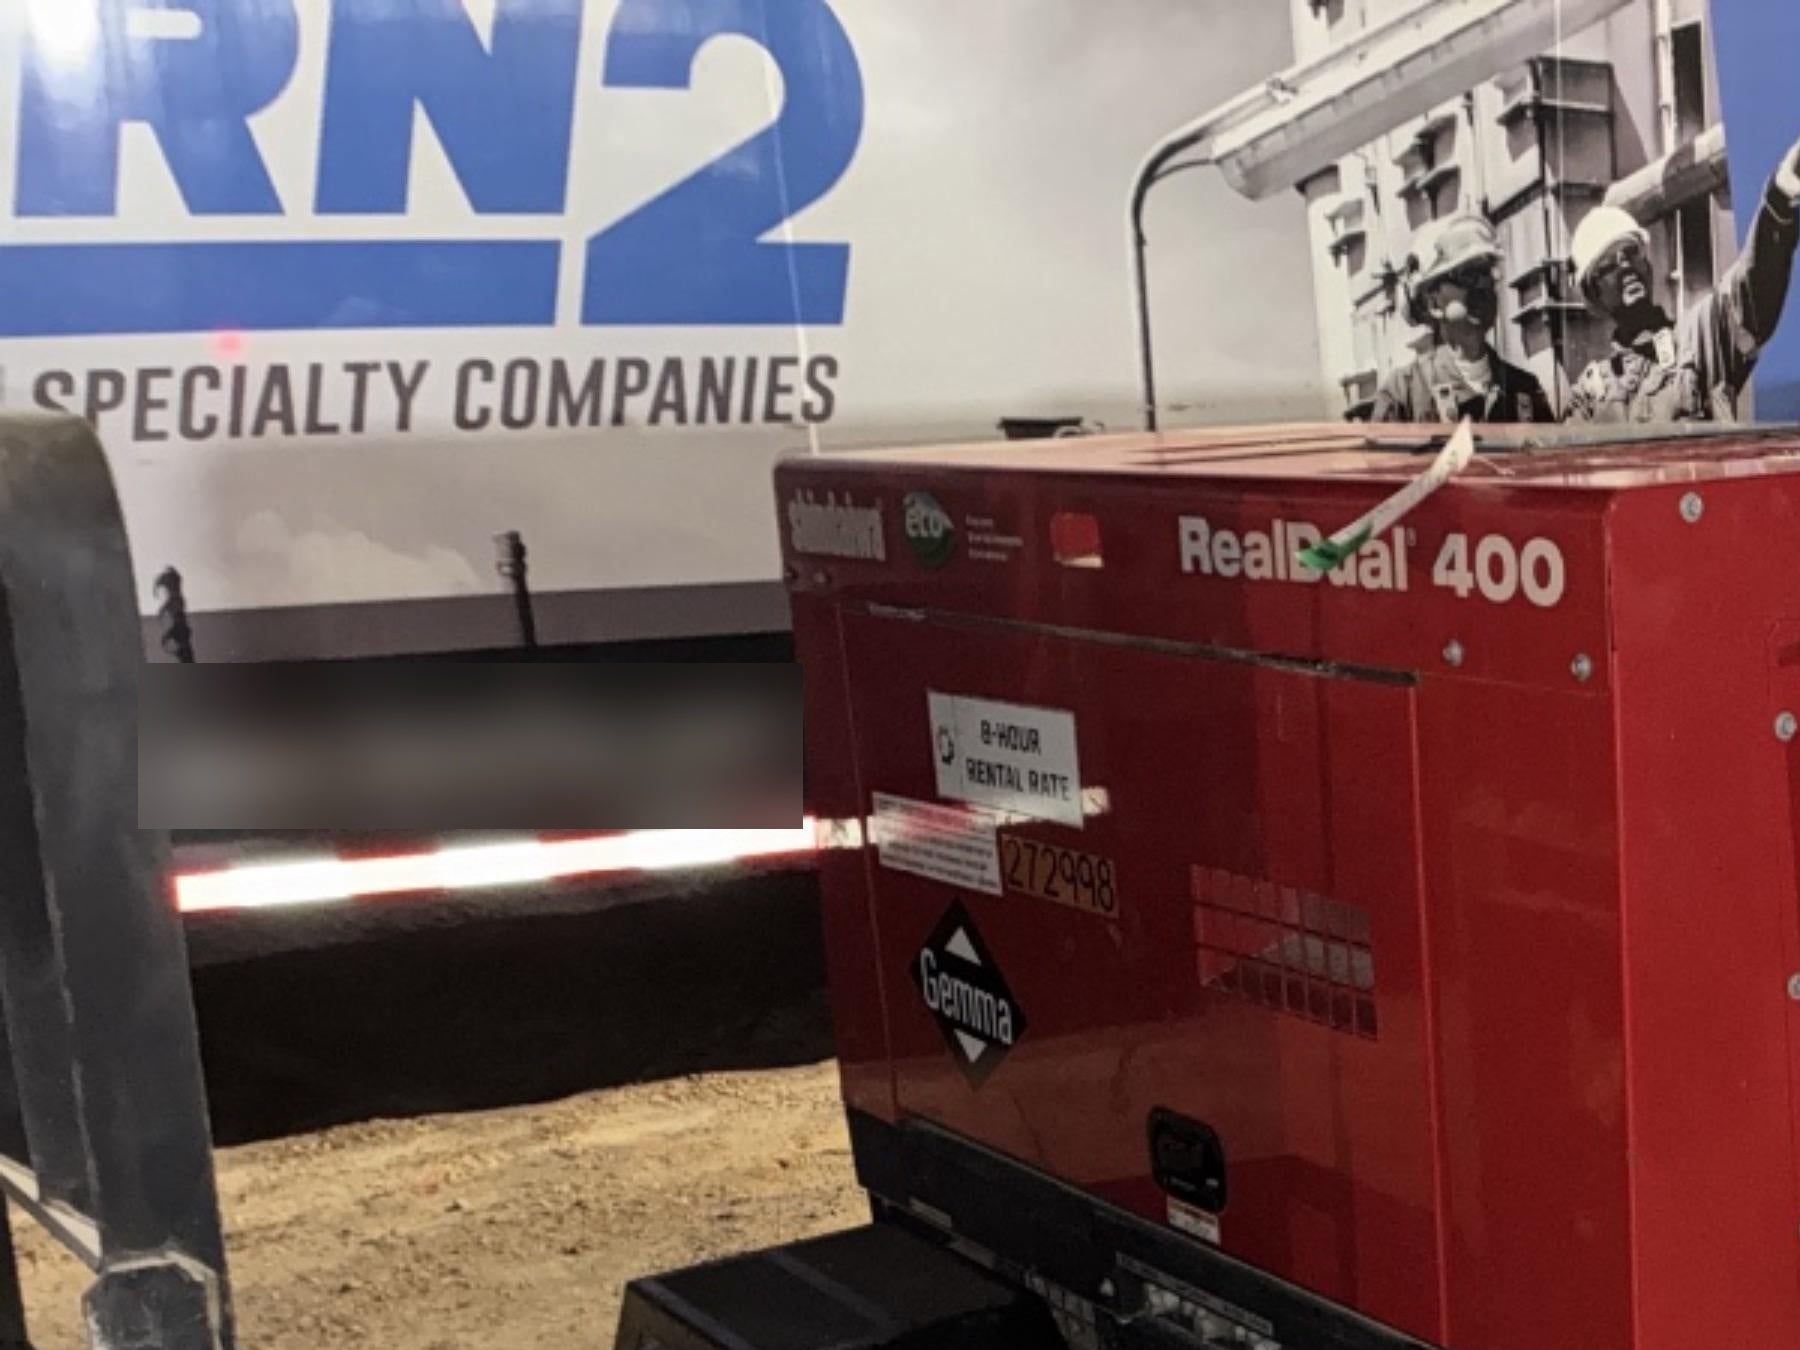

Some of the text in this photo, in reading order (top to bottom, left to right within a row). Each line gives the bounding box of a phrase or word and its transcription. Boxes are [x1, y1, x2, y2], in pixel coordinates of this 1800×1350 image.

[32, 355, 839, 443] SPECIALTY COMPANIES
[1432, 532, 1567, 608] 400
[980, 719, 1042, 756] 8-HOUR
[966, 756, 1070, 801] RENTAL RATE
[1005, 838, 1115, 914] 272998
[919, 946, 1014, 1046] Gemma
